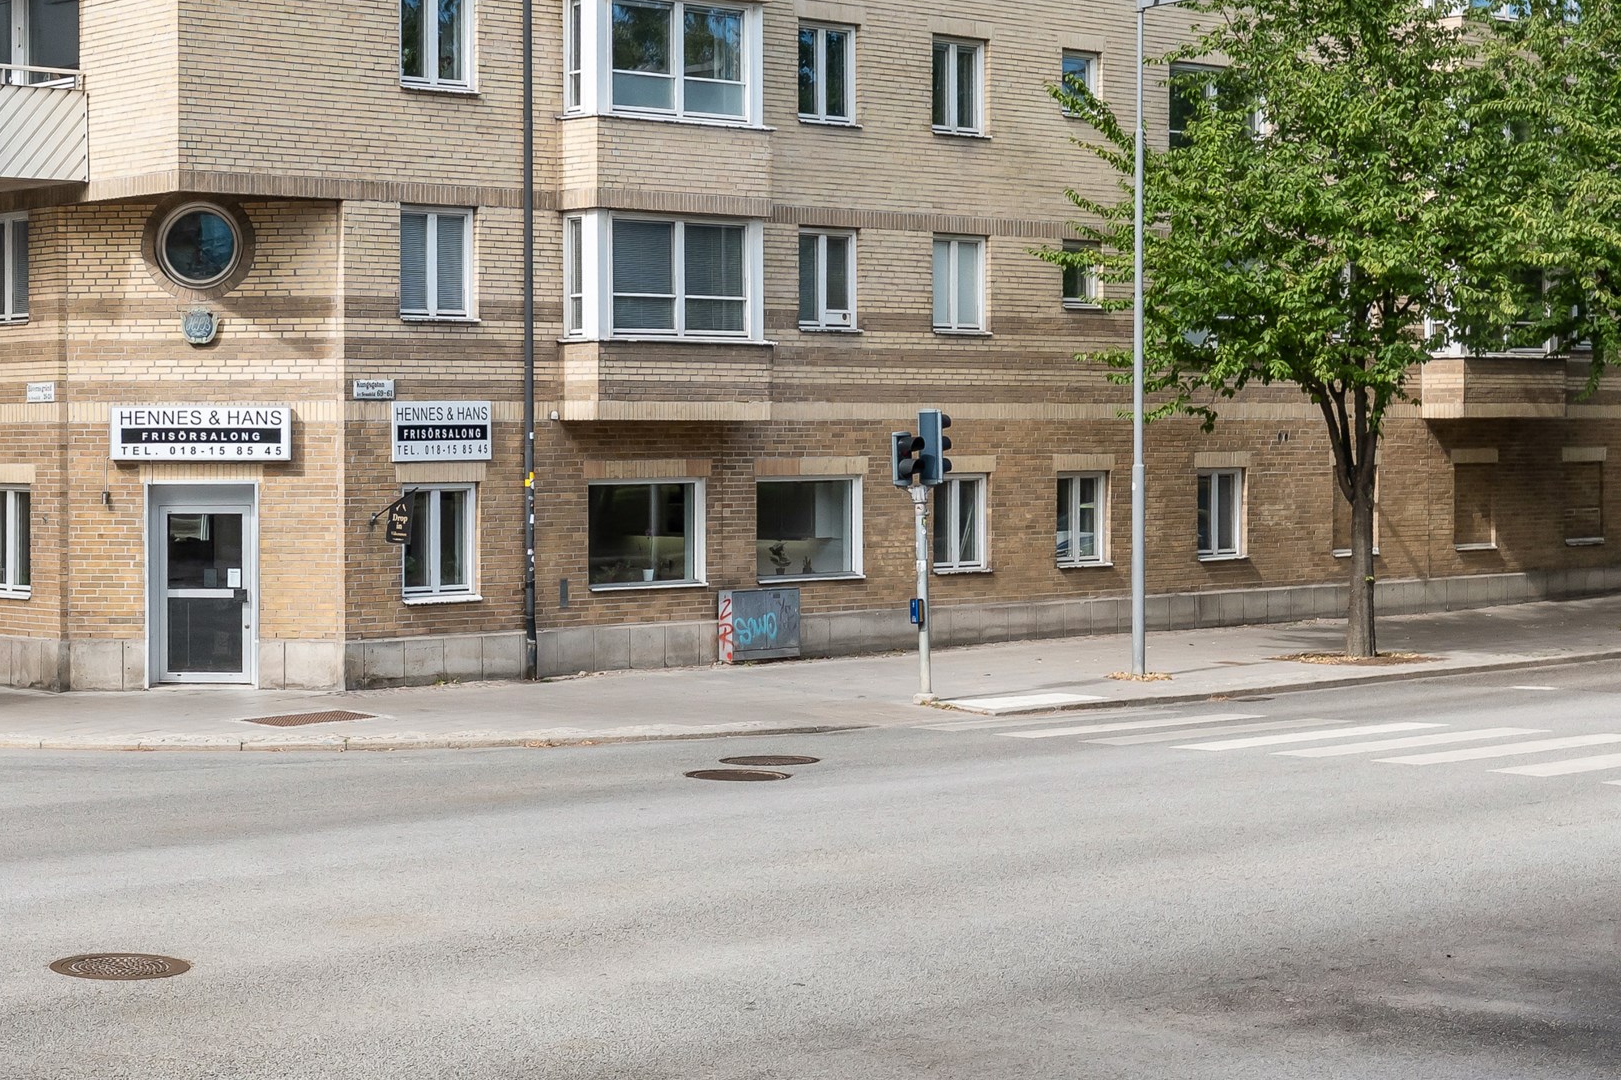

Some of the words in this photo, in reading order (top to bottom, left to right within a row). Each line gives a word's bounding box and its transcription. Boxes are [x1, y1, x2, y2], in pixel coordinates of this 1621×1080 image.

[120, 410, 202, 426] HENNES
[208, 410, 221, 426] &
[227, 410, 283, 426] HANS
[396, 407, 444, 422] HENNES
[446, 406, 454, 421] &
[457, 406, 488, 421] HANS
[141, 430, 261, 442] FRISÖRSALONG
[403, 427, 481, 440] FRISÖRSALONG
[121, 446, 159, 456] TEL.
[169, 446, 226, 456] 018-15
[236, 446, 254, 456] 85
[264, 446, 282, 456] 45
[397, 445, 420, 456] TEL.
[424, 444, 457, 455] 018-15
[462, 444, 473, 455] 85
[477, 444, 488, 455] 45
[392, 513, 408, 524] Drop
[396, 521, 403, 530] in
